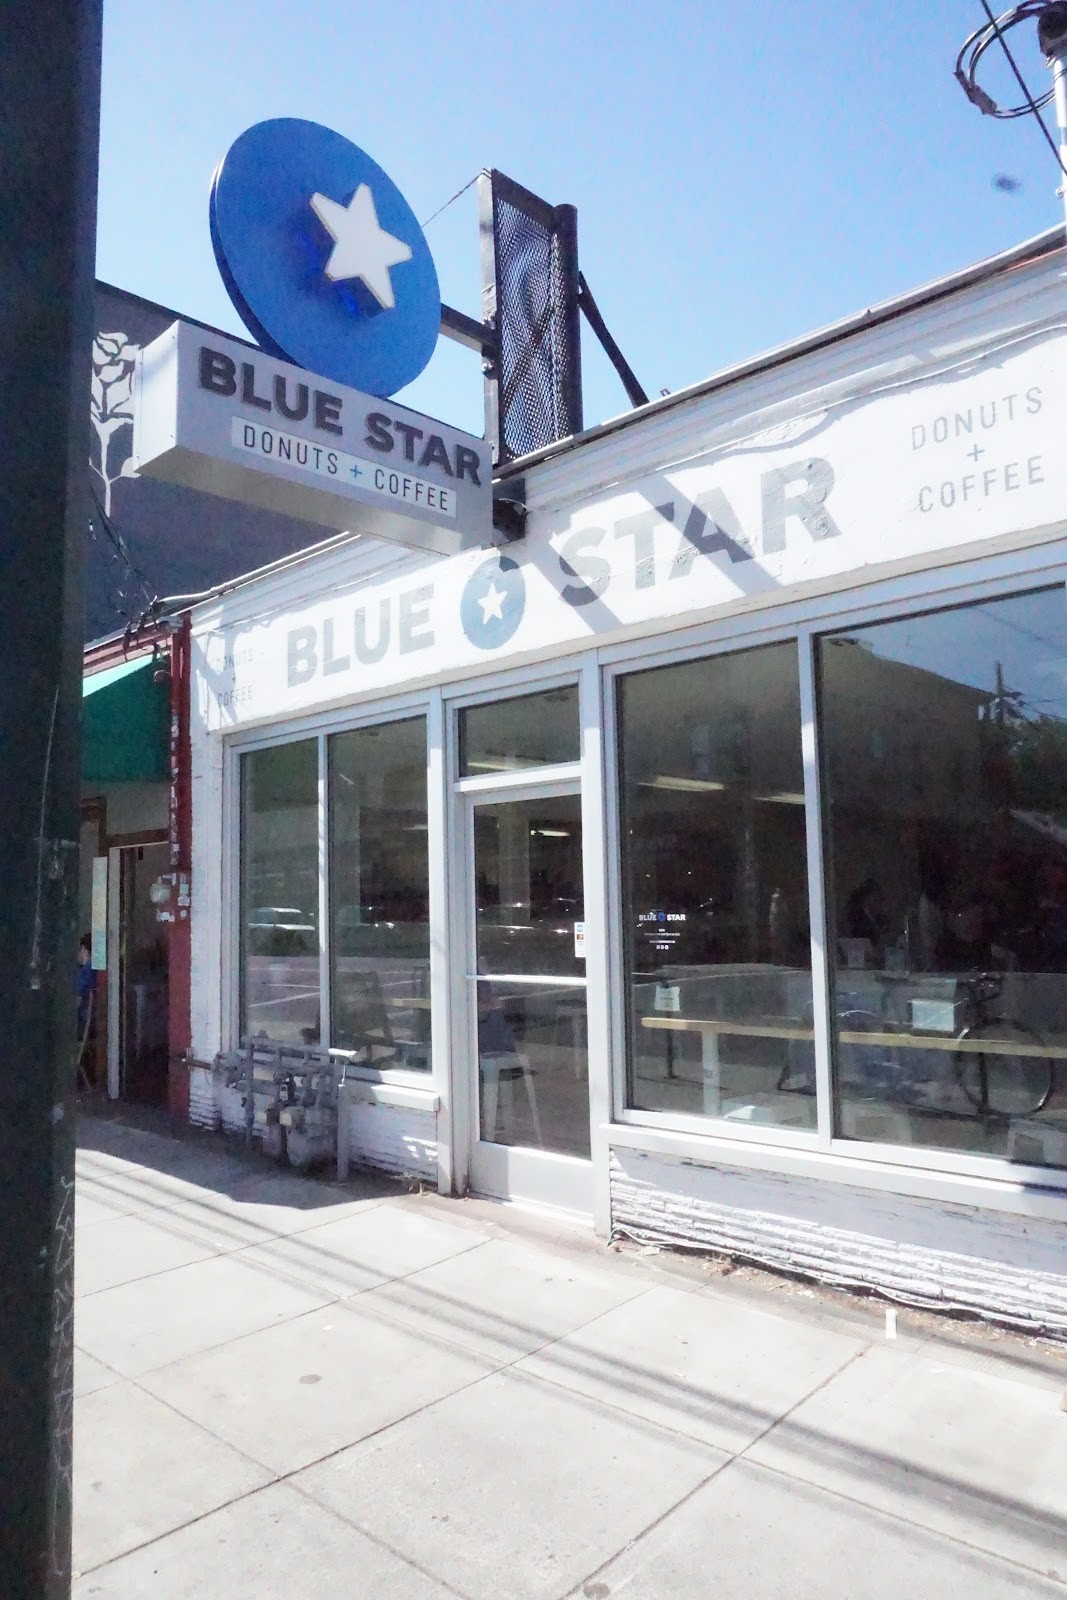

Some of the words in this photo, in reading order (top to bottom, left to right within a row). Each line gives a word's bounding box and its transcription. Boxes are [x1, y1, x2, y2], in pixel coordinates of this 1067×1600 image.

[199, 346, 344, 437] BLUE
[364, 411, 482, 487] STAR
[911, 386, 1042, 450] DONUTS
[243, 424, 338, 476] DONUTS
[349, 463, 363, 479] +
[374, 468, 449, 512] COFFEE
[918, 455, 1045, 513] COFFEE
[966, 443, 985, 462] +
[287, 583, 436, 688] BLUE
[558, 456, 843, 607] STAR
[217, 685, 253, 707] COFFEE
